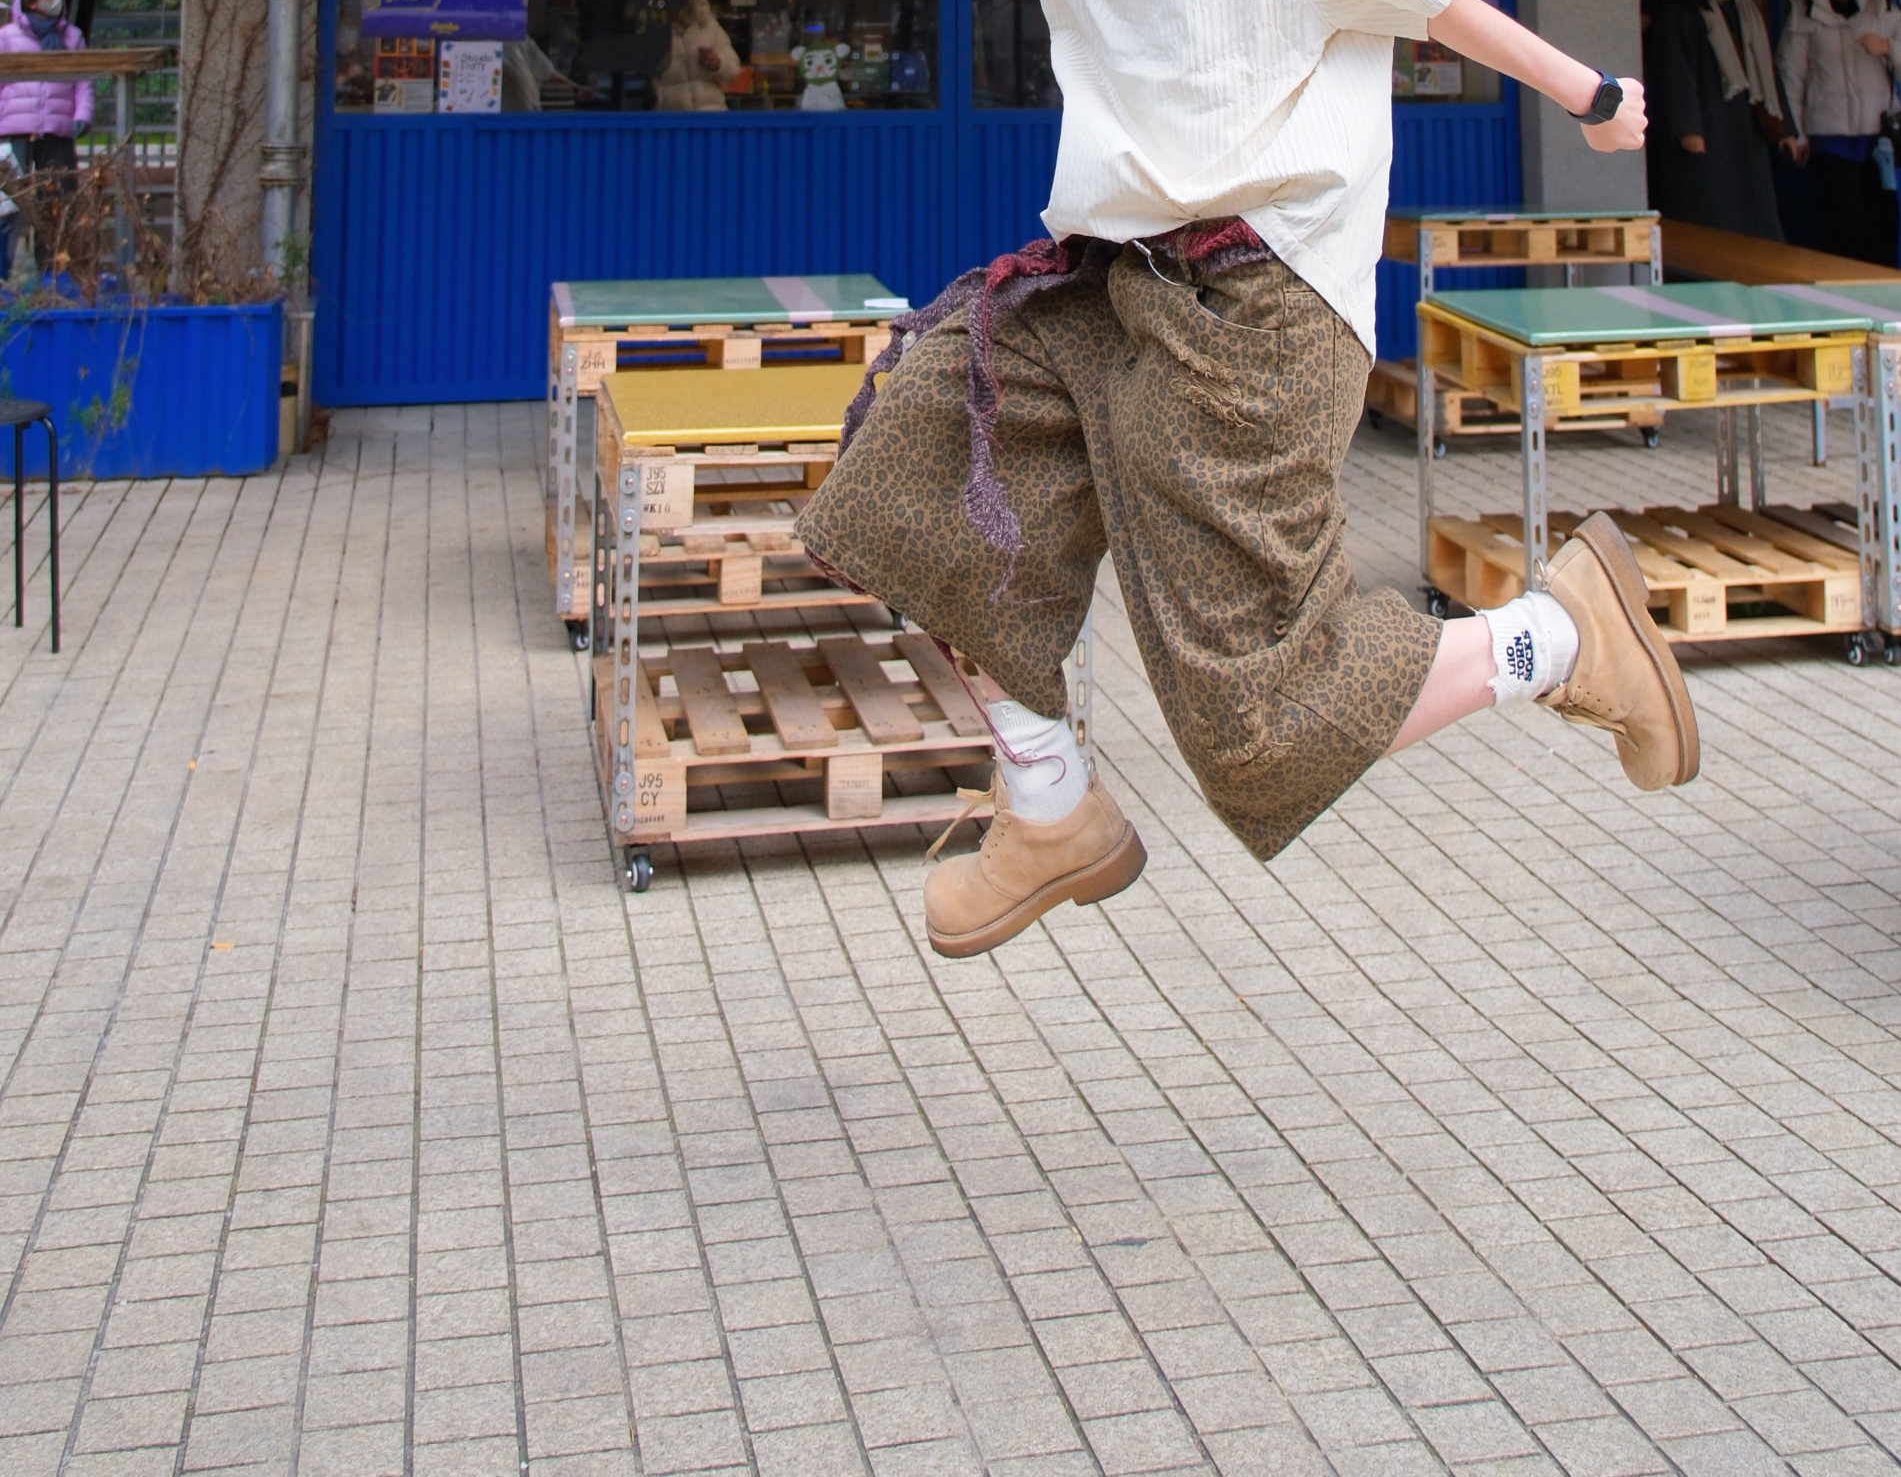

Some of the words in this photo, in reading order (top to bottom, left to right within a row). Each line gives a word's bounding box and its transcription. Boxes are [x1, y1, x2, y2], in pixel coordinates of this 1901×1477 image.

[646, 466, 667, 480] J95
[646, 480, 666, 495] SZY
[1513, 636, 1525, 680] TORN
[1521, 630, 1534, 682] SOCKS
[639, 773, 663, 788] J95
[641, 791, 659, 806] CY
